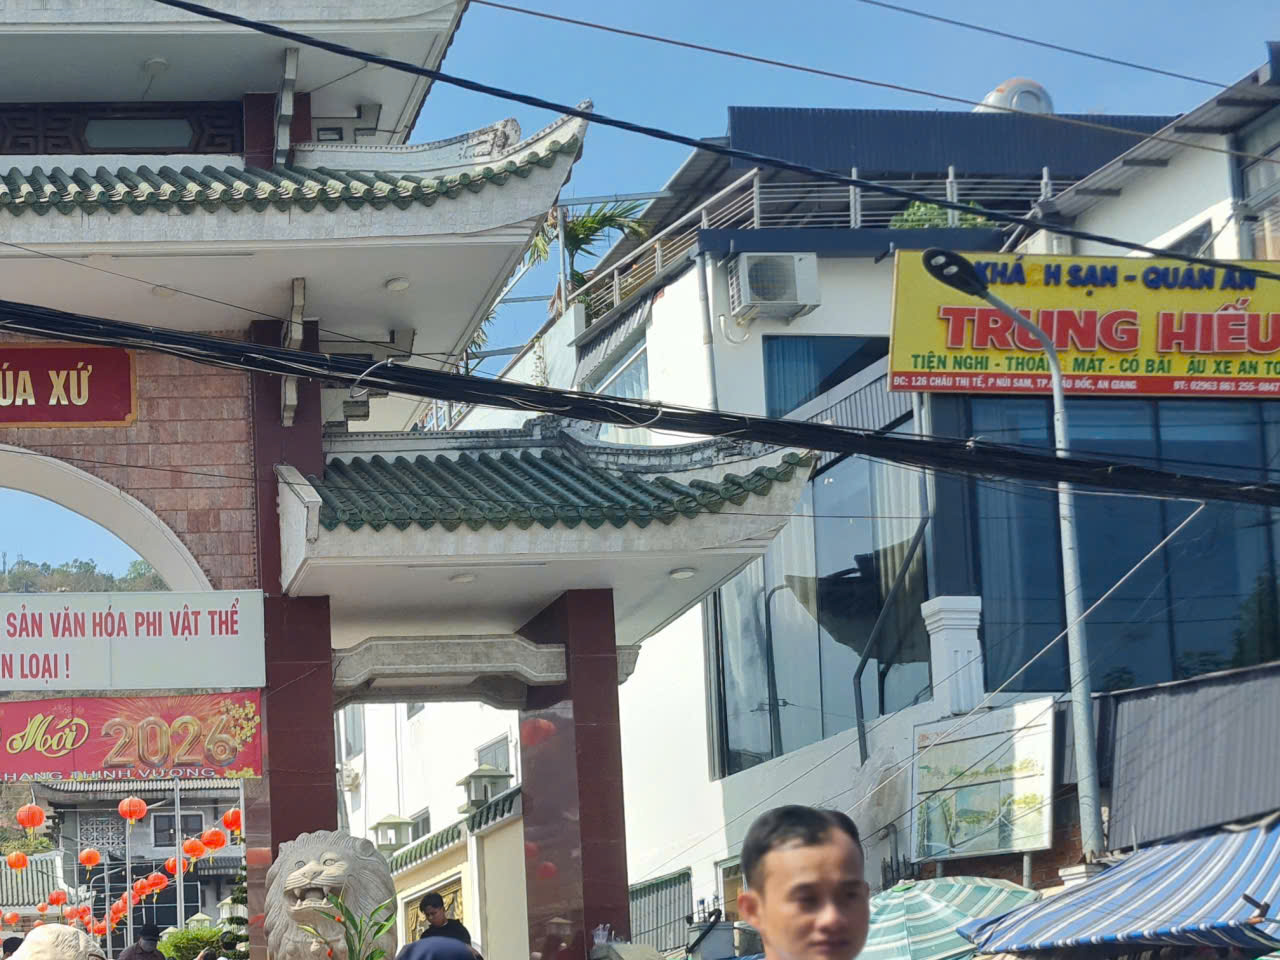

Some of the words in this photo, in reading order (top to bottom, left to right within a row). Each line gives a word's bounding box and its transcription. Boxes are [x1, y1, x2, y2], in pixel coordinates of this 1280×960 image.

[974, 254, 1061, 286] KHÁH
[1066, 264, 1118, 297] SẠN
[938, 306, 1140, 352] TRUNG
[1158, 297, 1280, 353] HIẾU
[48, 361, 93, 406] XỨ
[912, 351, 947, 371] TIỆN
[953, 355, 989, 371] NGHI
[1073, 354, 1105, 373] MÁT
[1120, 354, 1139, 373] CÓ
[1145, 355, 1172, 374] BÃI
[1213, 360, 1232, 375] XE
[1237, 360, 1258, 375] AN
[929, 375, 952, 387] CHÂU
[6, 604, 43, 638] SẢN
[49, 606, 86, 637] VĂN
[92, 605, 128, 637] HÓA
[135, 611, 162, 637] PHI
[169, 604, 201, 641] VẬT
[207, 598, 240, 636] THỂ
[20, 653, 58, 684] LOẠI
[6, 713, 89, 758] Mới
[100, 715, 238, 768] 2026
